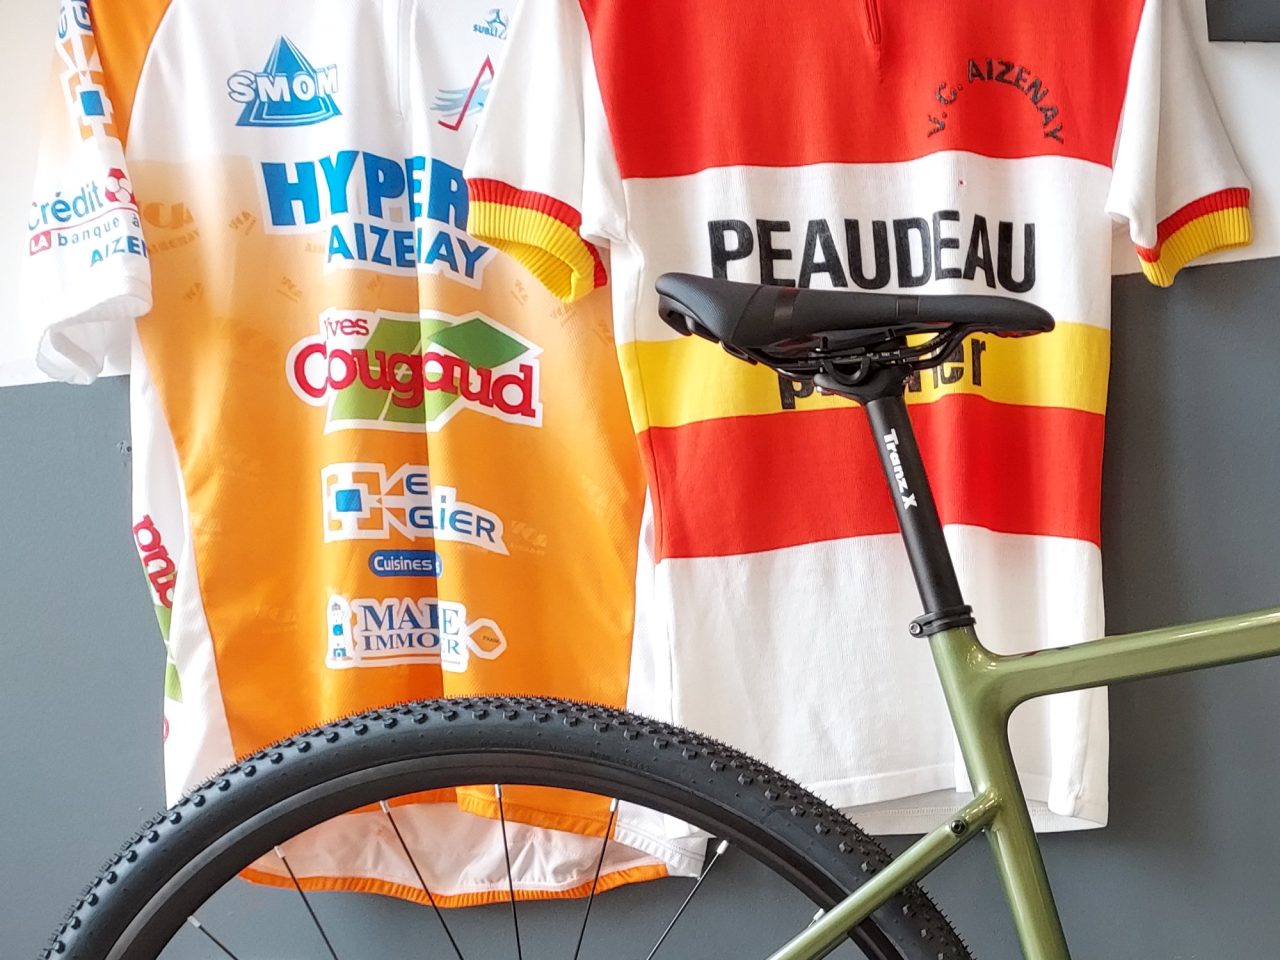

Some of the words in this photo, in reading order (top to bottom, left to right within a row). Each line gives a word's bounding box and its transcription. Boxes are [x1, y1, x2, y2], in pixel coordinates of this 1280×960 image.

[227, 62, 339, 104] SMOM
[967, 57, 1065, 144] AIZENAY
[260, 150, 469, 231] HYPER
[31, 232, 51, 255] LA
[57, 215, 120, 247] banque
[707, 210, 1036, 293] PEAUDEAU
[293, 342, 536, 418] Cougaud
[373, 555, 433, 571] Cuisines
